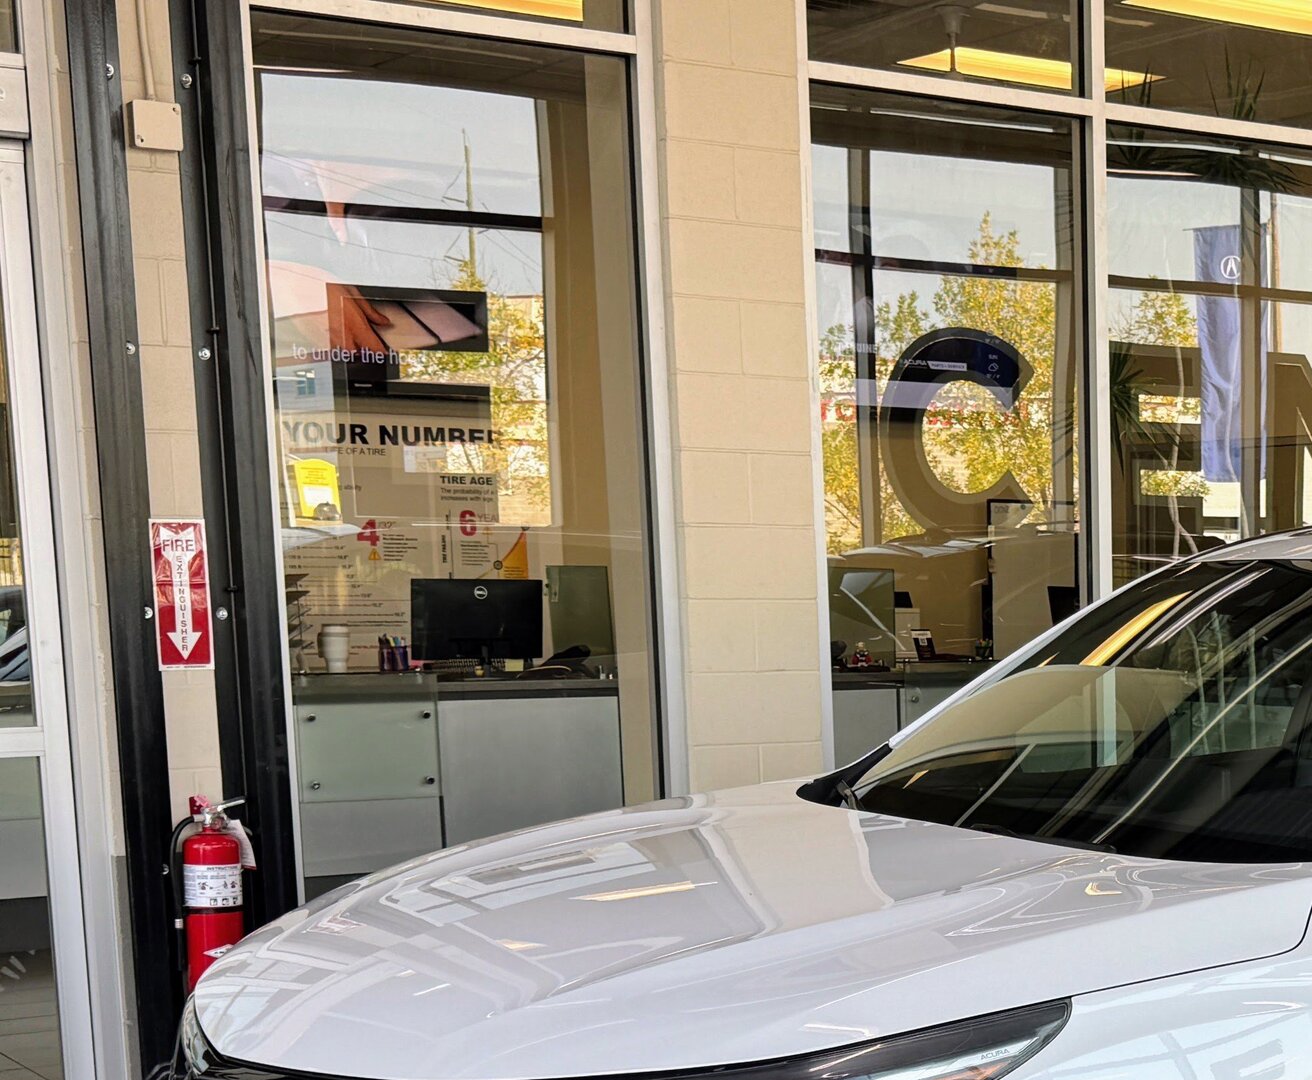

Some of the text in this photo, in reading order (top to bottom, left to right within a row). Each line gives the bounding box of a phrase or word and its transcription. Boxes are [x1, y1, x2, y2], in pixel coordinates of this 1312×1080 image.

[292, 343, 307, 360] to
[312, 346, 357, 363] under
[360, 347, 385, 364] the
[282, 421, 369, 445] YOUR
[367, 448, 386, 456] TIRE
[440, 475, 493, 486] TIRE AGE
[357, 519, 380, 547] 4
[459, 510, 477, 536] 6
[162, 539, 195, 552] FIRE
[176, 555, 189, 651] EXTINGUISHER
[981, 1048, 1010, 1061] ACURA
